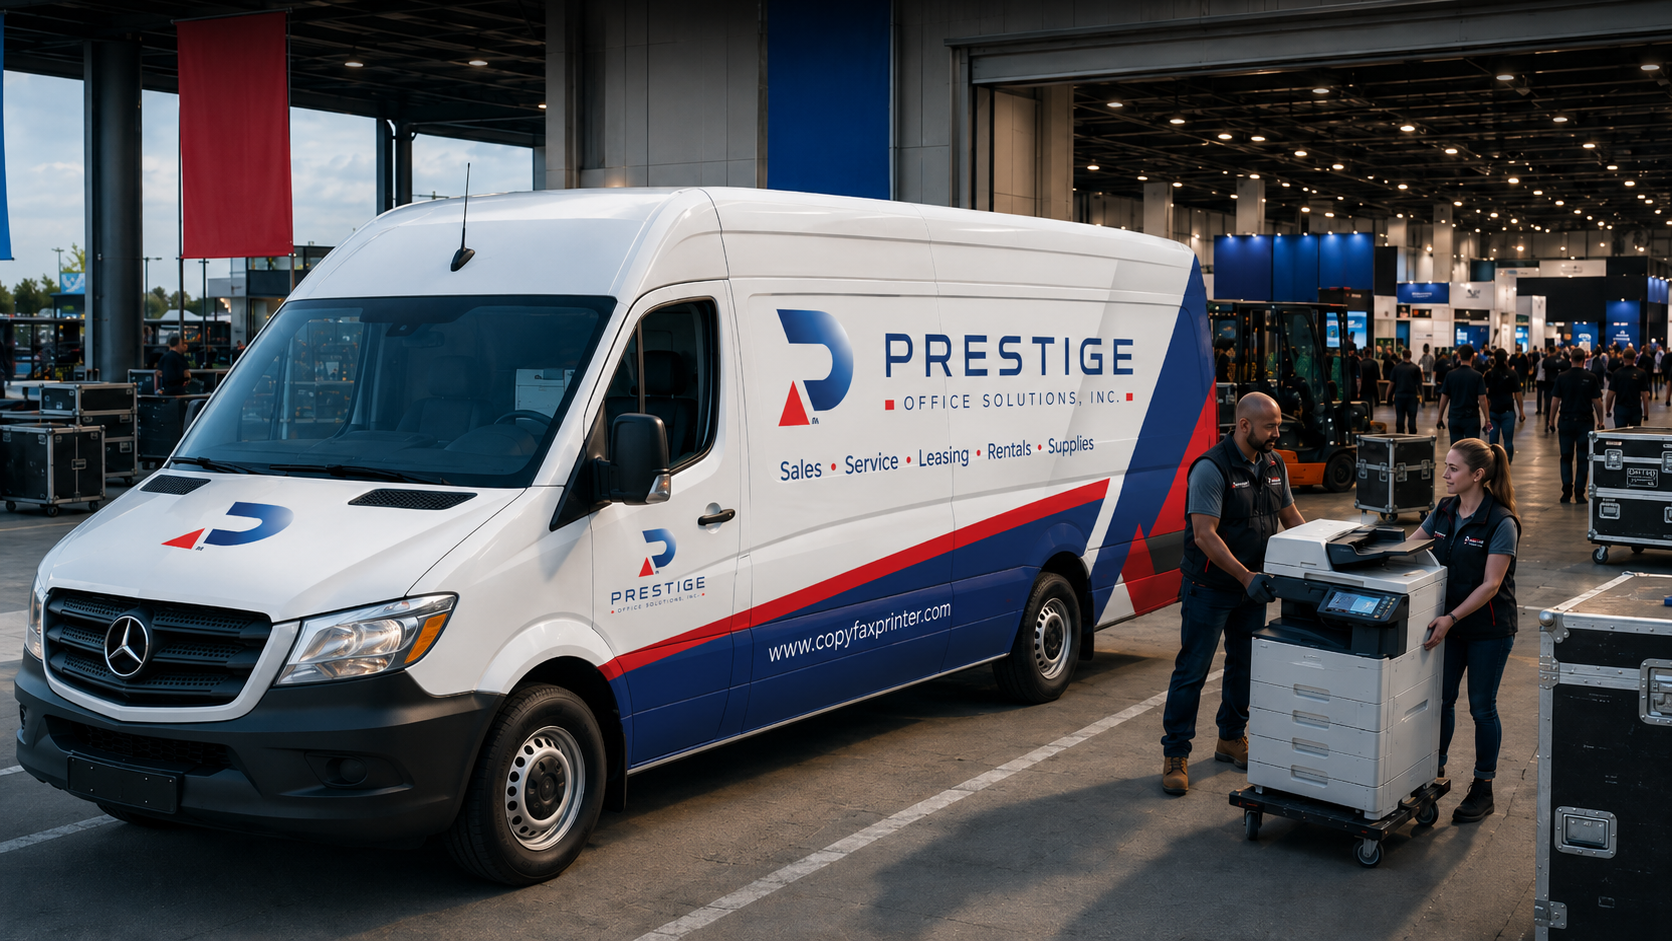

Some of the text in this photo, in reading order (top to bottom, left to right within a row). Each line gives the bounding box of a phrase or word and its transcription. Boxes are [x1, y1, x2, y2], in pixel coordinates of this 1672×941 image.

[884, 332, 1134, 378] PRESTIGE
[903, 390, 1120, 411] OFFICE SOLUTIONS, INC.
[780, 434, 1095, 482] Sales Service Leasing Rentals Supplies
[610, 576, 706, 606] PRESTIGE
[768, 602, 952, 662] www.copyfaxprinter.com
